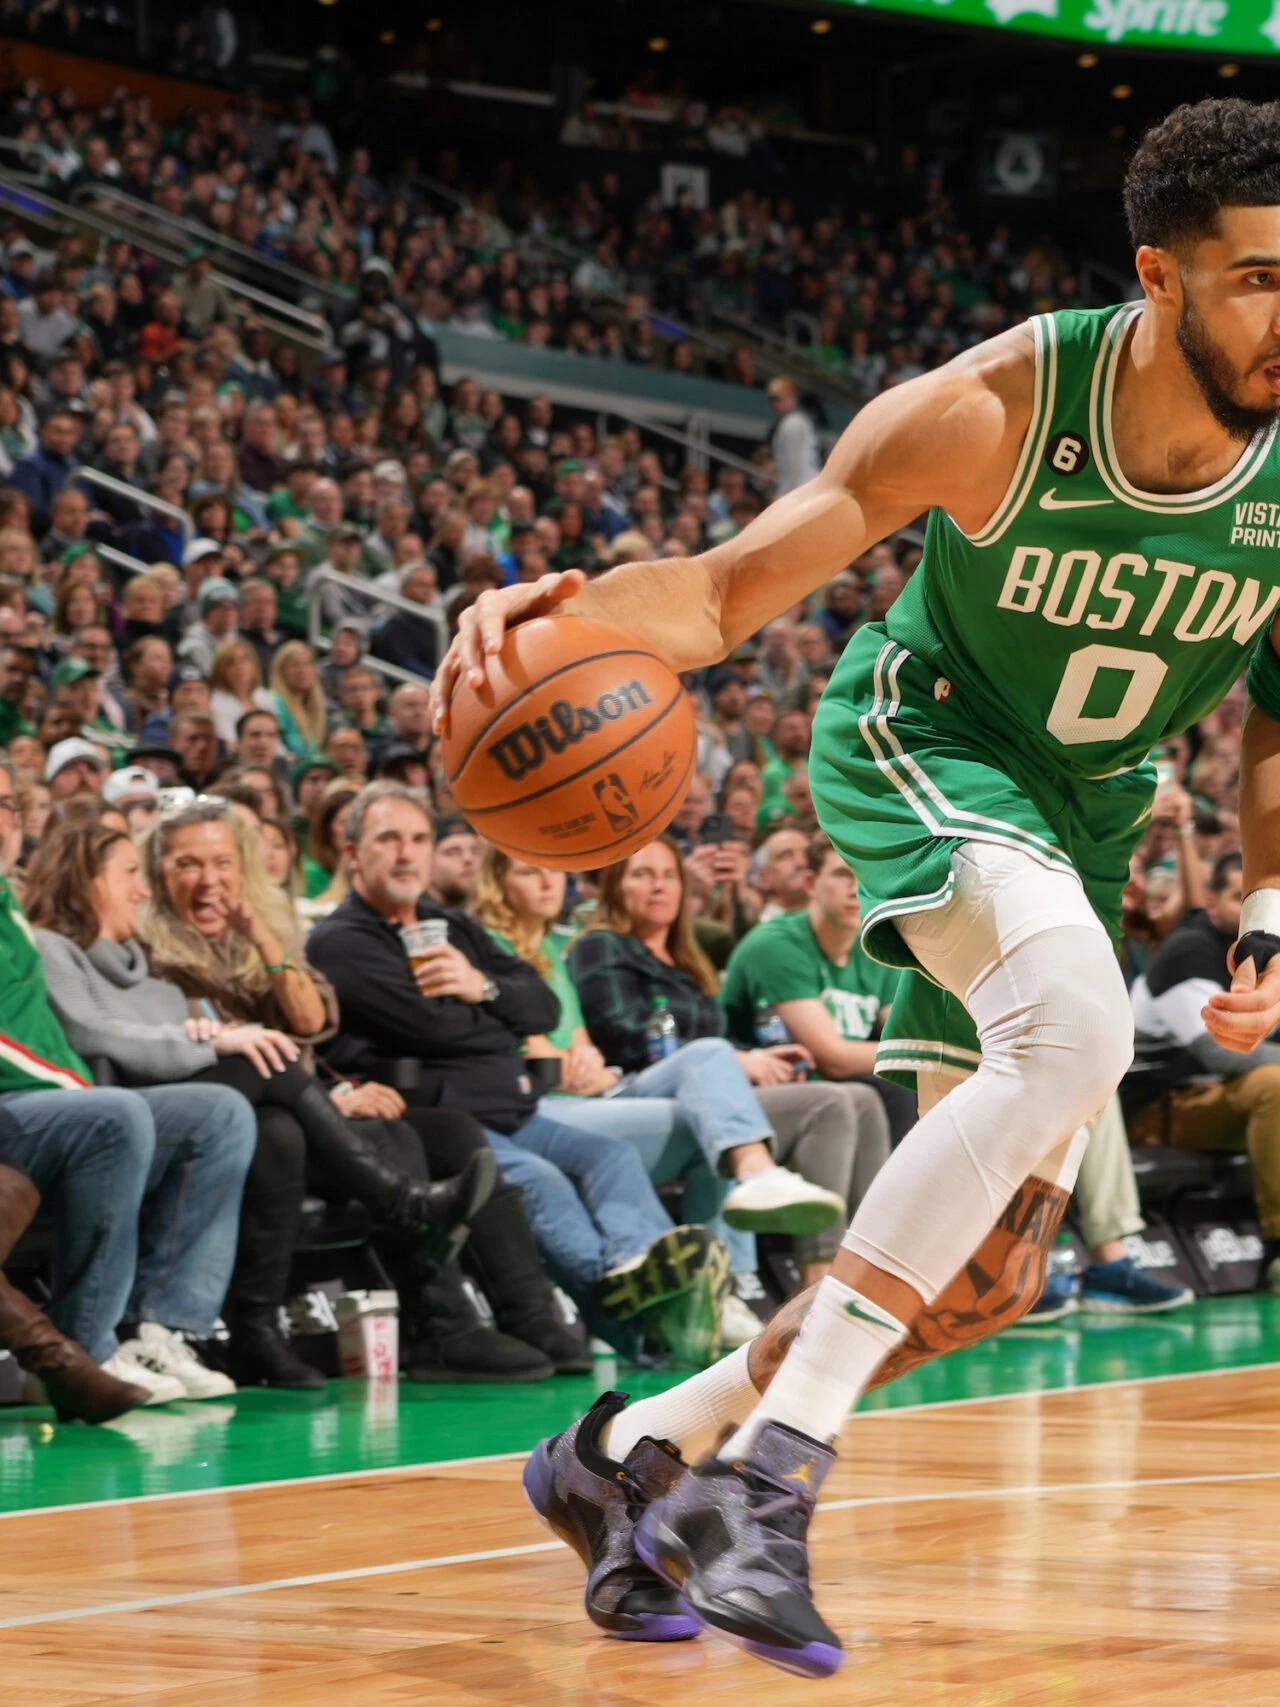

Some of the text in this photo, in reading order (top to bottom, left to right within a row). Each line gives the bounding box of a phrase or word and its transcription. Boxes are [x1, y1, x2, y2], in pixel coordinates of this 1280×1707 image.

[1052, 437, 1082, 472] 6
[488, 679, 652, 782] Wilson
[1045, 643, 1169, 746] 0
